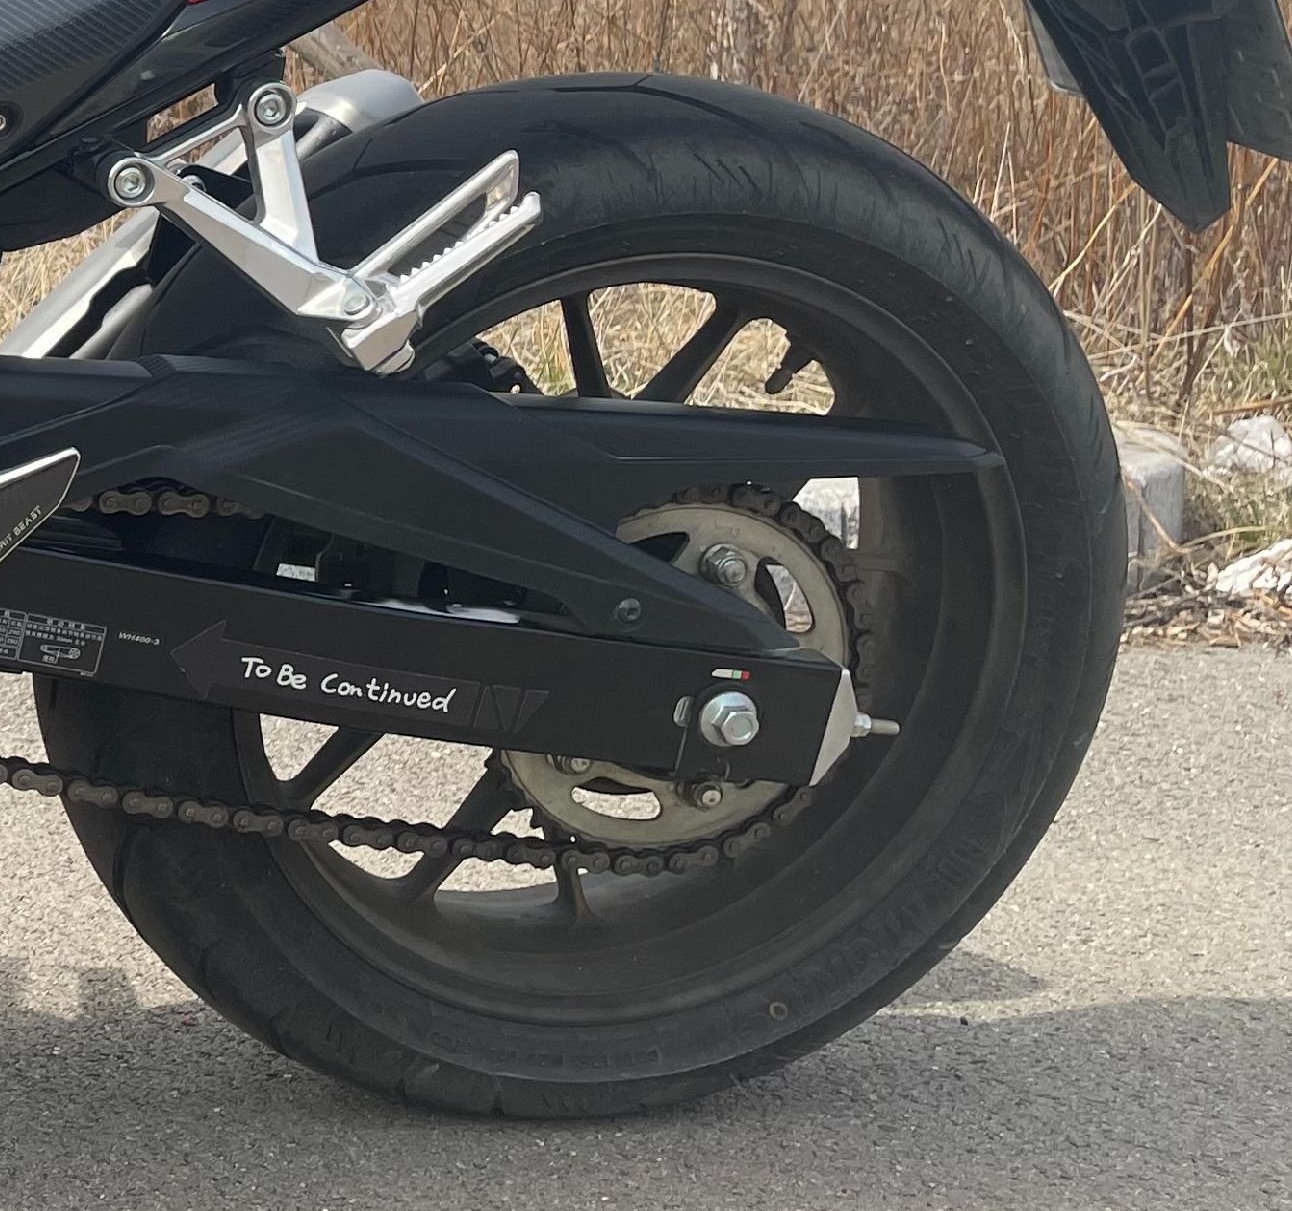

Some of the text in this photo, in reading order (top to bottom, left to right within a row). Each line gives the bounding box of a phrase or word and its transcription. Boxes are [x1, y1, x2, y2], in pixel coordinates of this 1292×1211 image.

[12, 504, 42, 536] BEAST
[240, 657, 457, 713] To Be Continued
